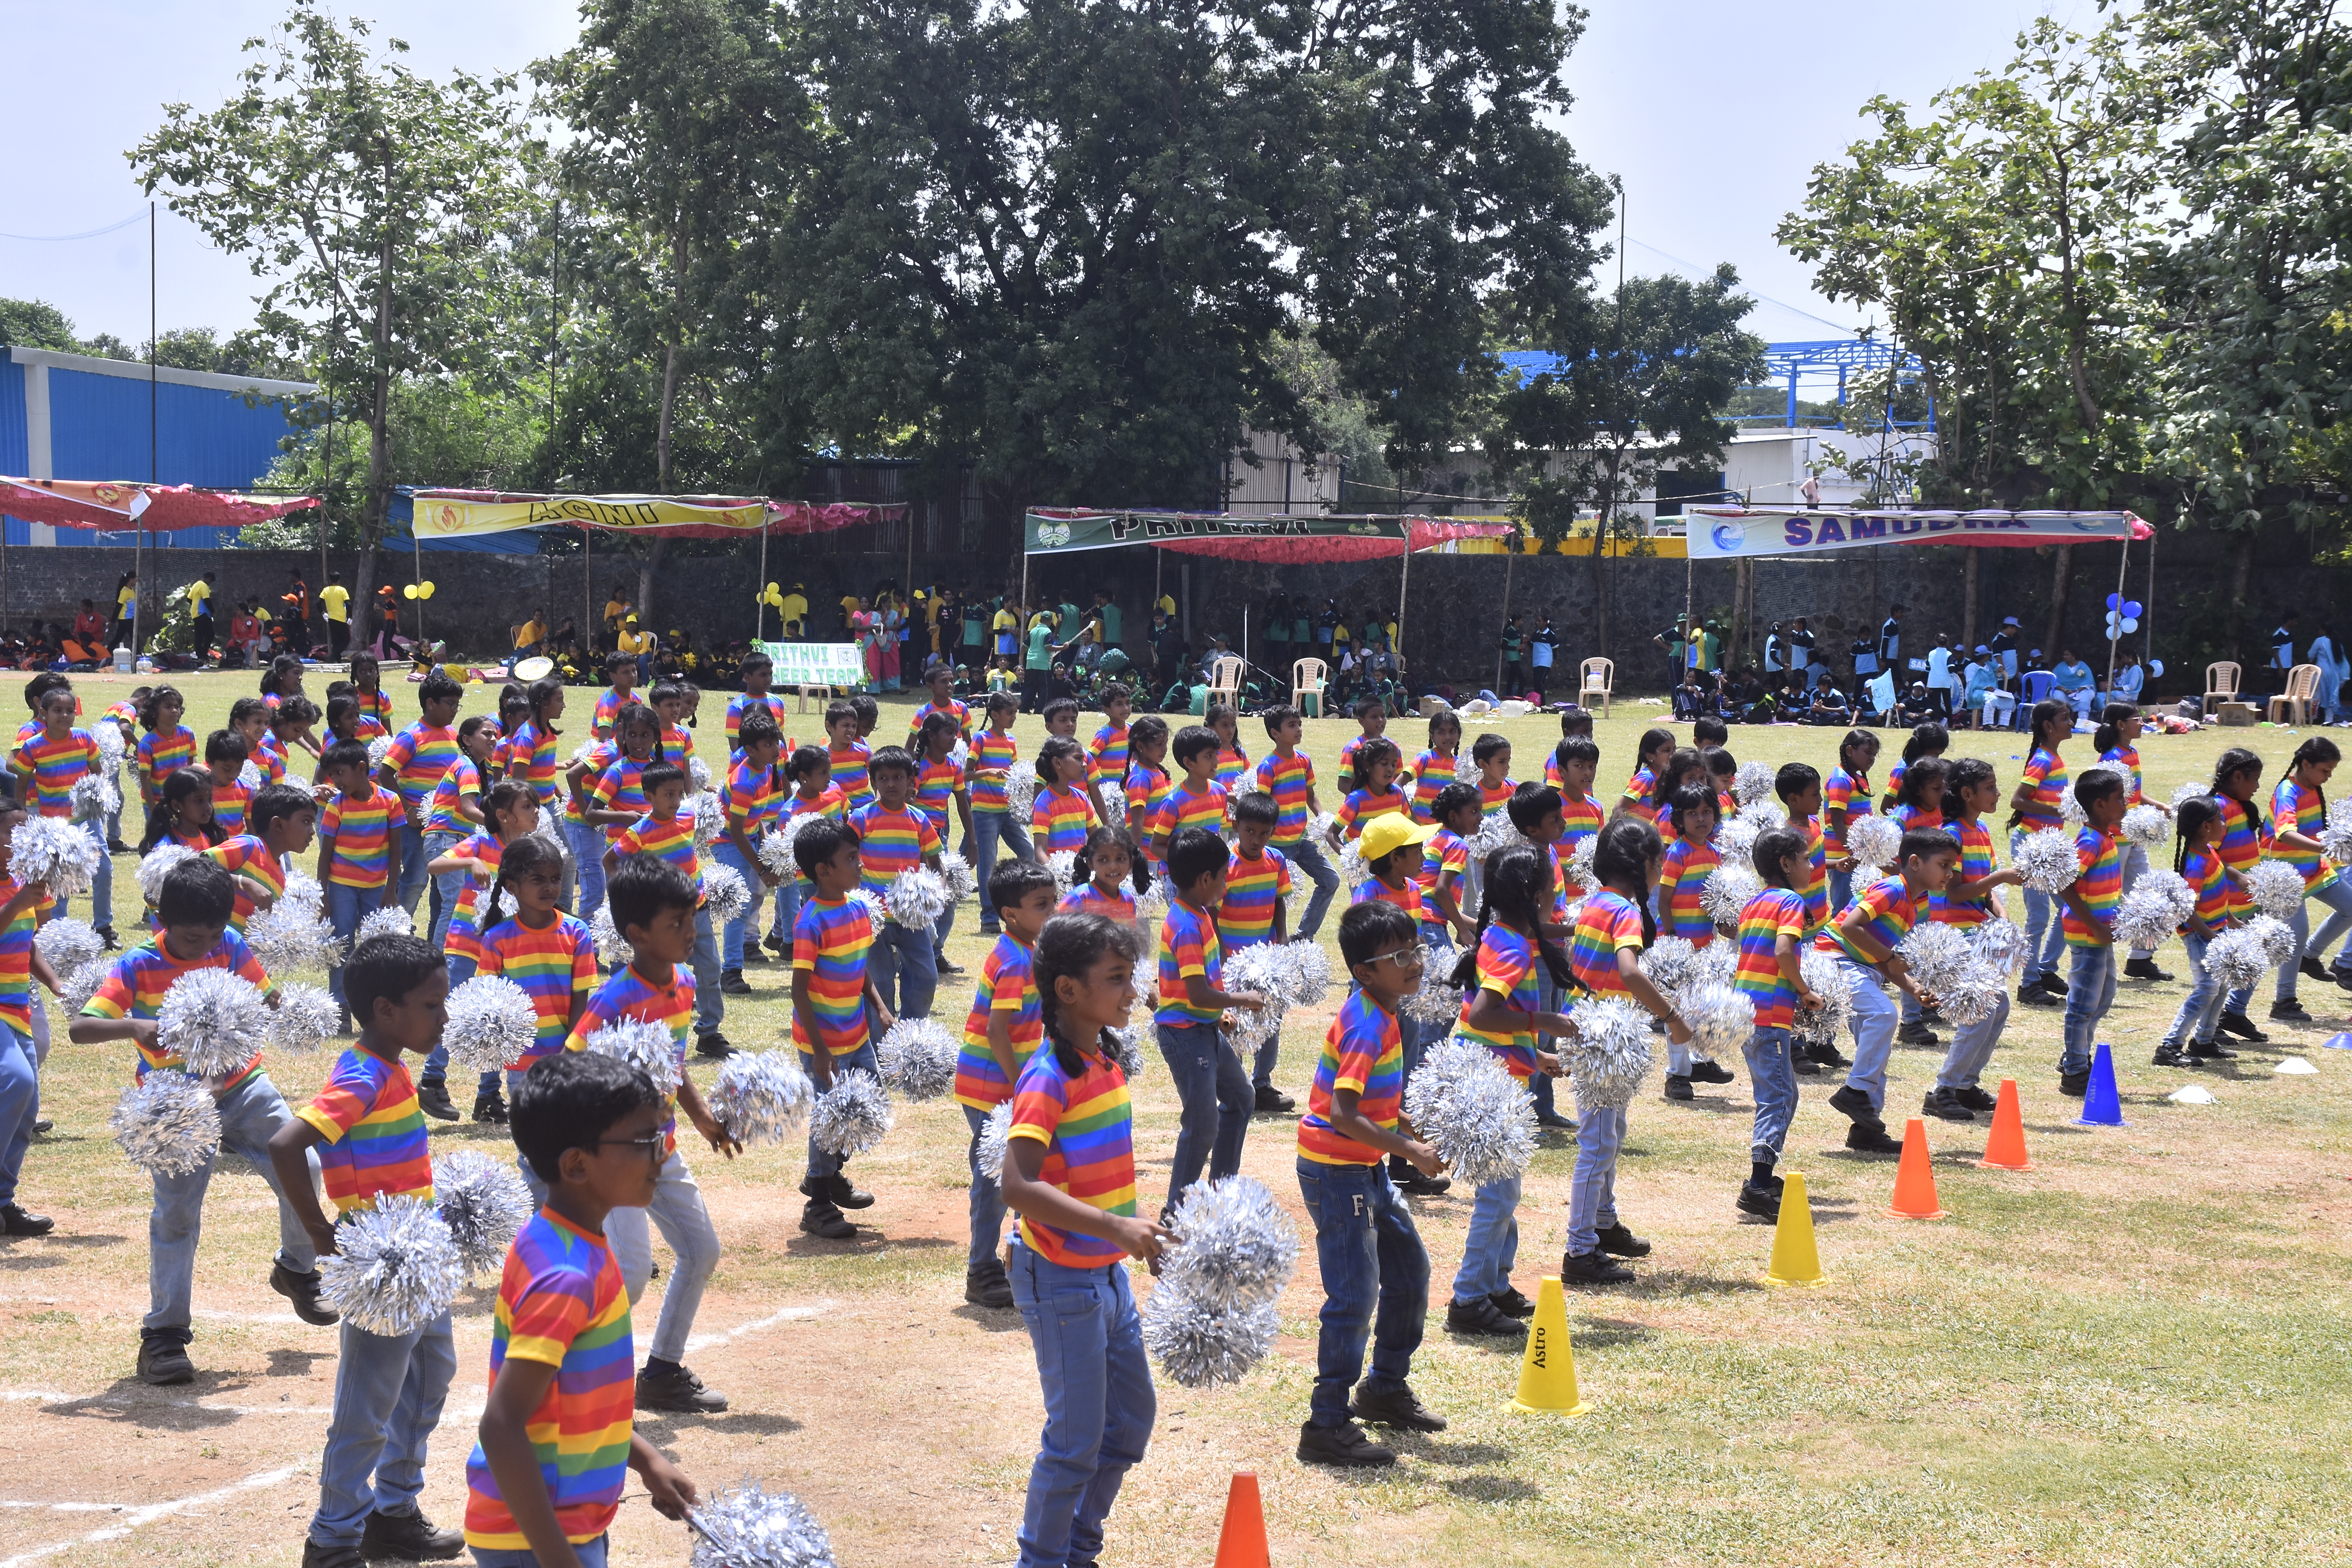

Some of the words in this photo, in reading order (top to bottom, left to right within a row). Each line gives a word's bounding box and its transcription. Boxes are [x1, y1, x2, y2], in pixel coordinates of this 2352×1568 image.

[530, 499, 659, 525] AGNI
[761, 644, 829, 661] PRITHVI
[772, 667, 811, 683] HEER
[815, 668, 859, 684] TEAM
[1532, 1327, 1546, 1369] Astro
